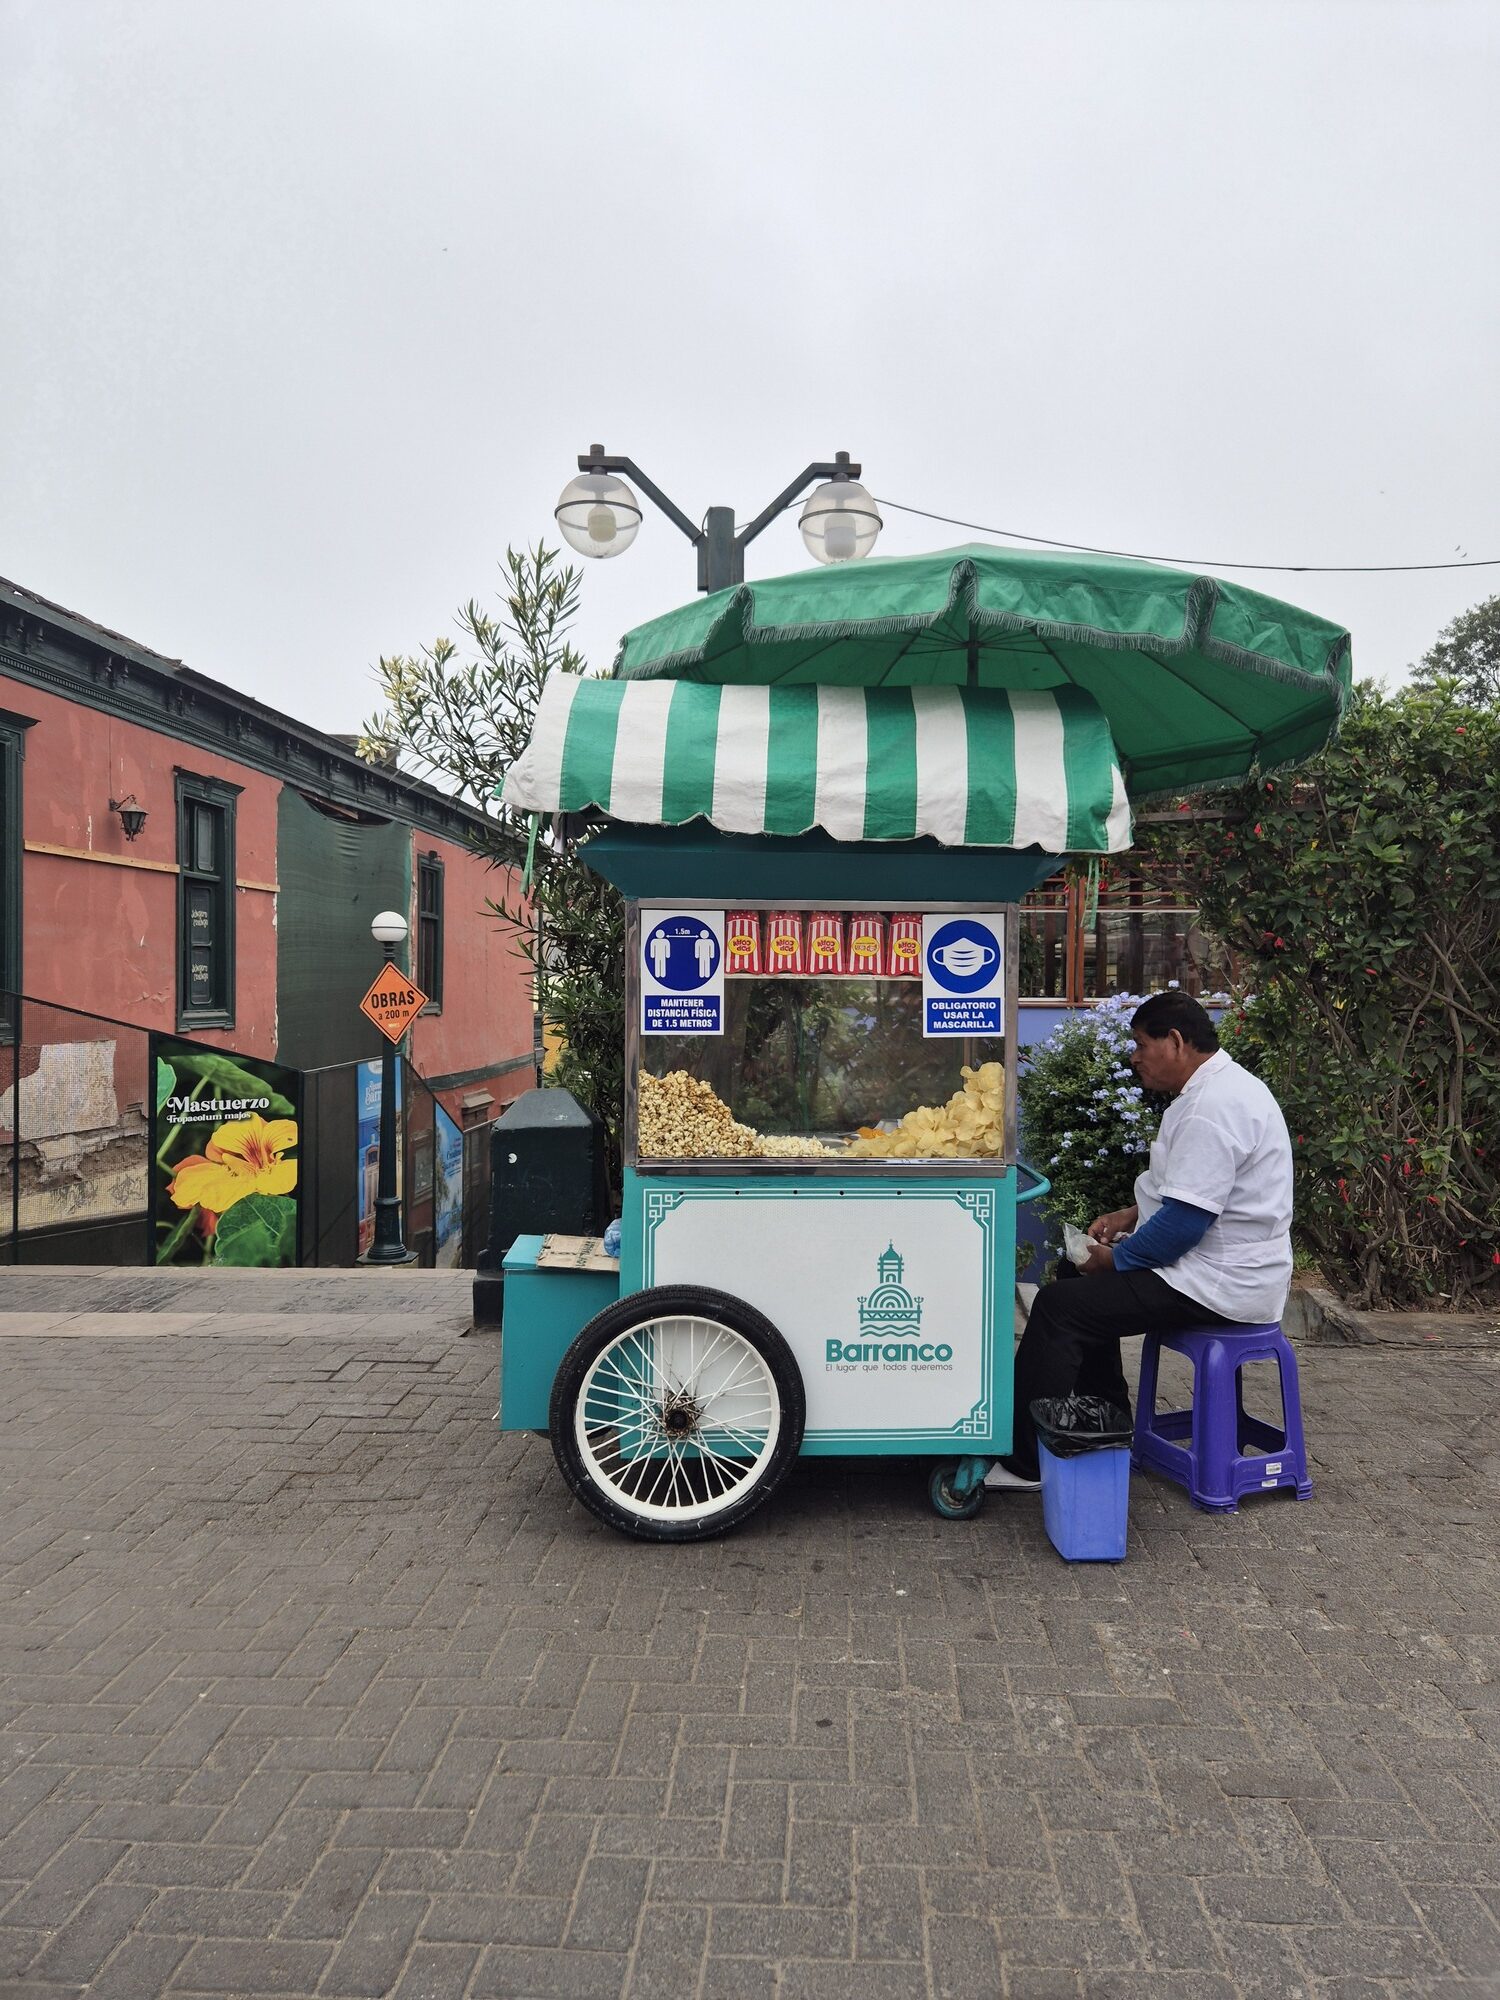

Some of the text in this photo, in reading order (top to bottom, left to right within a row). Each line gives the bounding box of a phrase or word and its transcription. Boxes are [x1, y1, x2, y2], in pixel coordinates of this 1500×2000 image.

[732, 939, 751, 947] CORN
[775, 939, 795, 947] CORN
[371, 989, 415, 1009] OBRAS
[660, 999, 704, 1007] MANTENER
[931, 1001, 997, 1010] OBLIGATORIO
[385, 1009, 400, 1020] 200
[647, 1007, 717, 1018] DISTANCIA FÍSICA
[943, 1011, 985, 1019] USAR LA
[652, 1019, 713, 1028] DE 1.5 METROS
[933, 1020, 995, 1029] MASCARILLA
[166, 1096, 270, 1113] Mastuerzo
[826, 1339, 953, 1362] Barranco
[825, 1363, 953, 1373] El lugar que todos queremos
